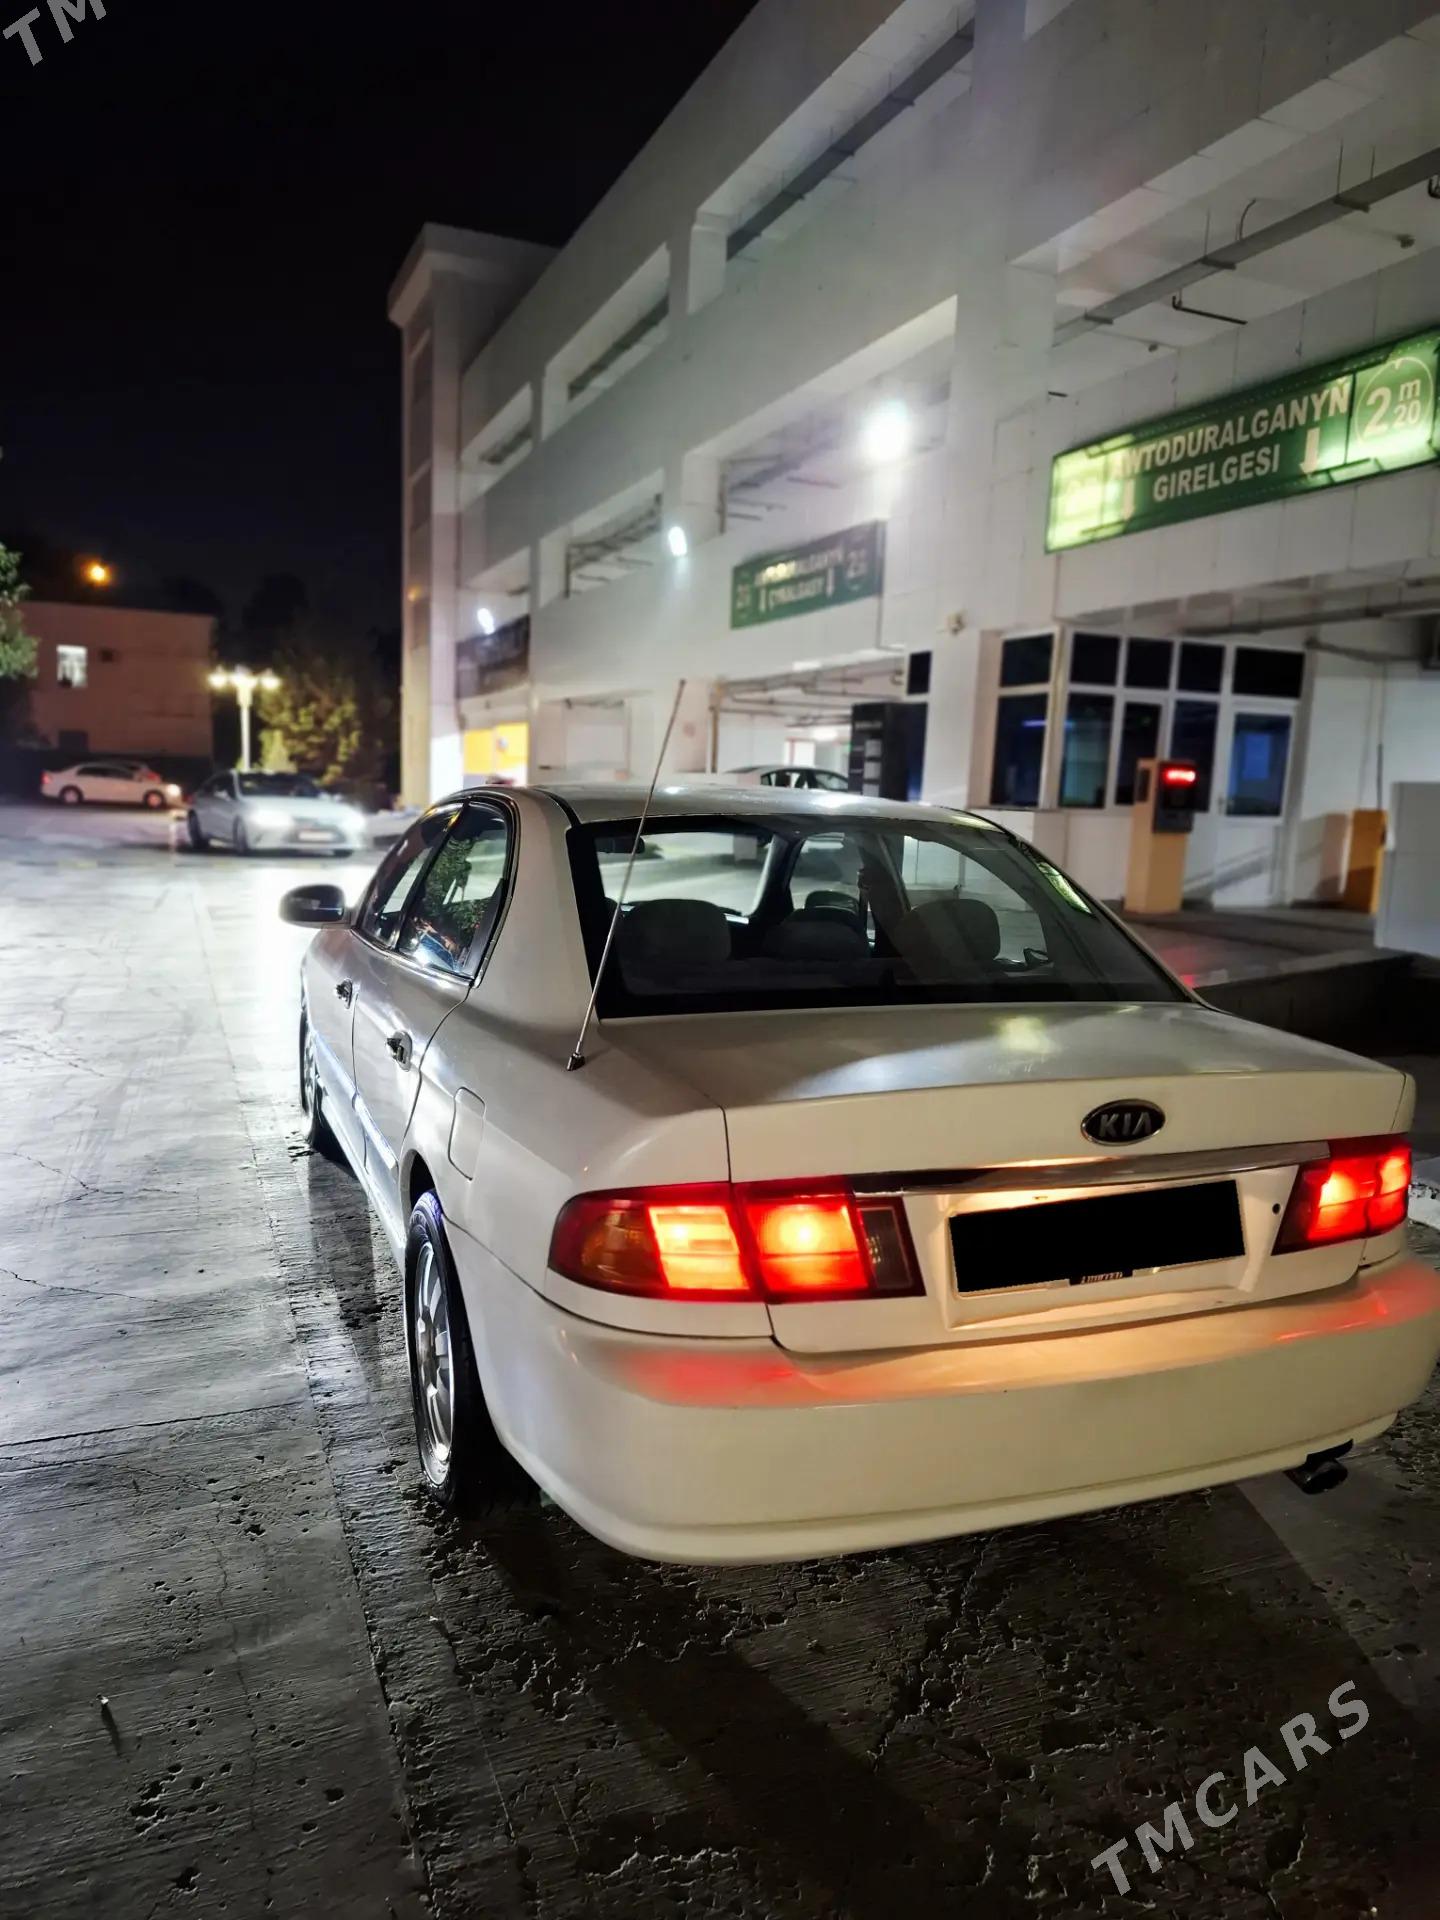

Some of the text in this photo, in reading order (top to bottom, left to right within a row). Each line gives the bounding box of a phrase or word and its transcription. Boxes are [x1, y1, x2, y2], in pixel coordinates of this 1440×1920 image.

[1363, 379, 1421, 438] 2 m
[1392, 400, 1421, 428] 20
[1153, 443, 1281, 501] GIRELGESI
[1100, 1111, 1152, 1138] KIA
